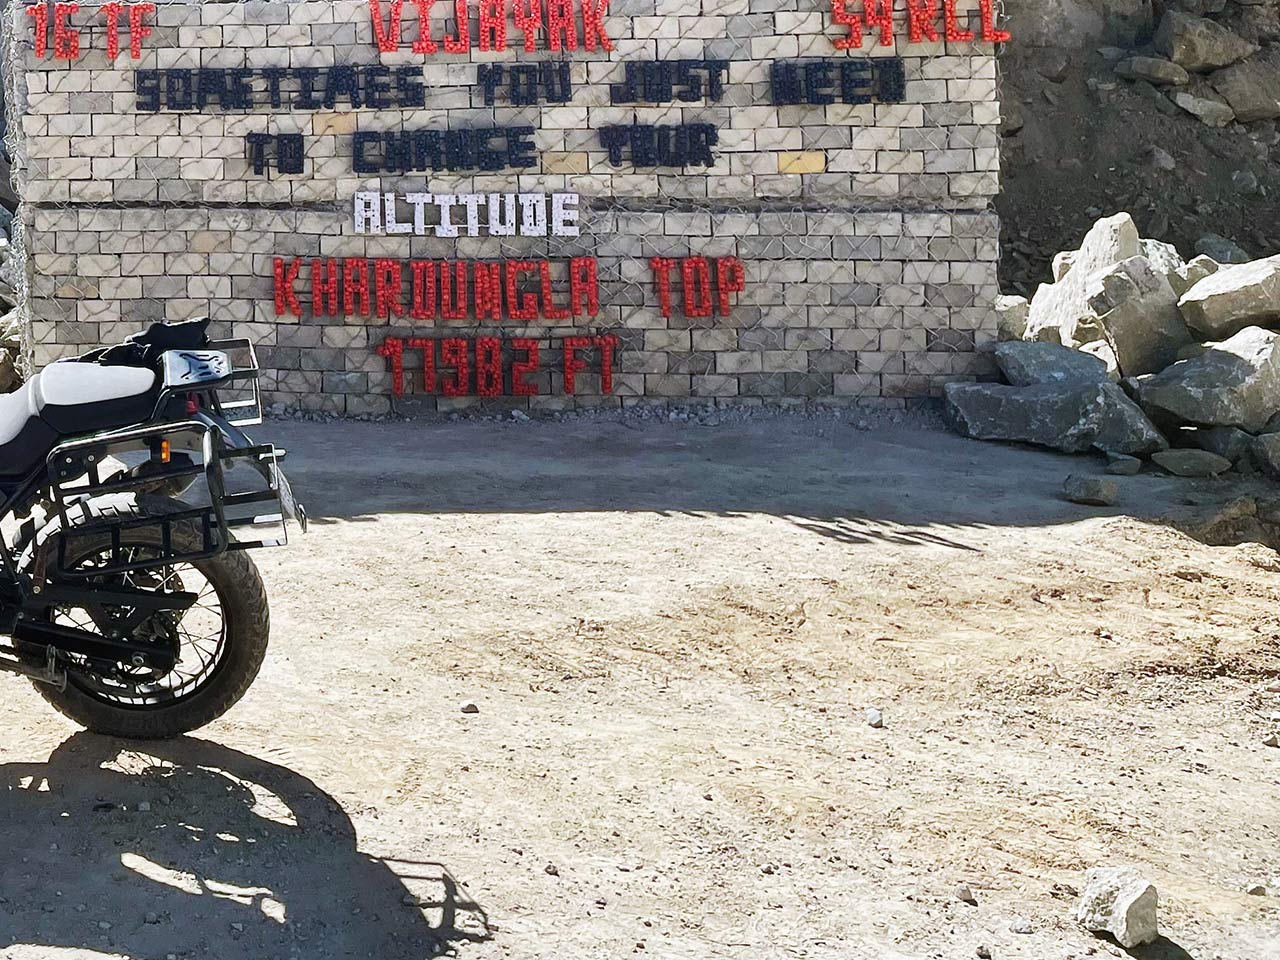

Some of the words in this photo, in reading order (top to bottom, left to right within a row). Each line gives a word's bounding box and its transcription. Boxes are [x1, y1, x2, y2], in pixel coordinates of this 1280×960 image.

[135, 67, 425, 110] SOMETIMES
[477, 61, 572, 105] YOU
[247, 131, 304, 175] TO
[354, 191, 580, 237] ALTITUDE
[273, 256, 599, 320] KHARDUNGLA
[651, 256, 745, 318] TOP
[377, 336, 539, 397] 17982
[563, 336, 618, 394] FT
